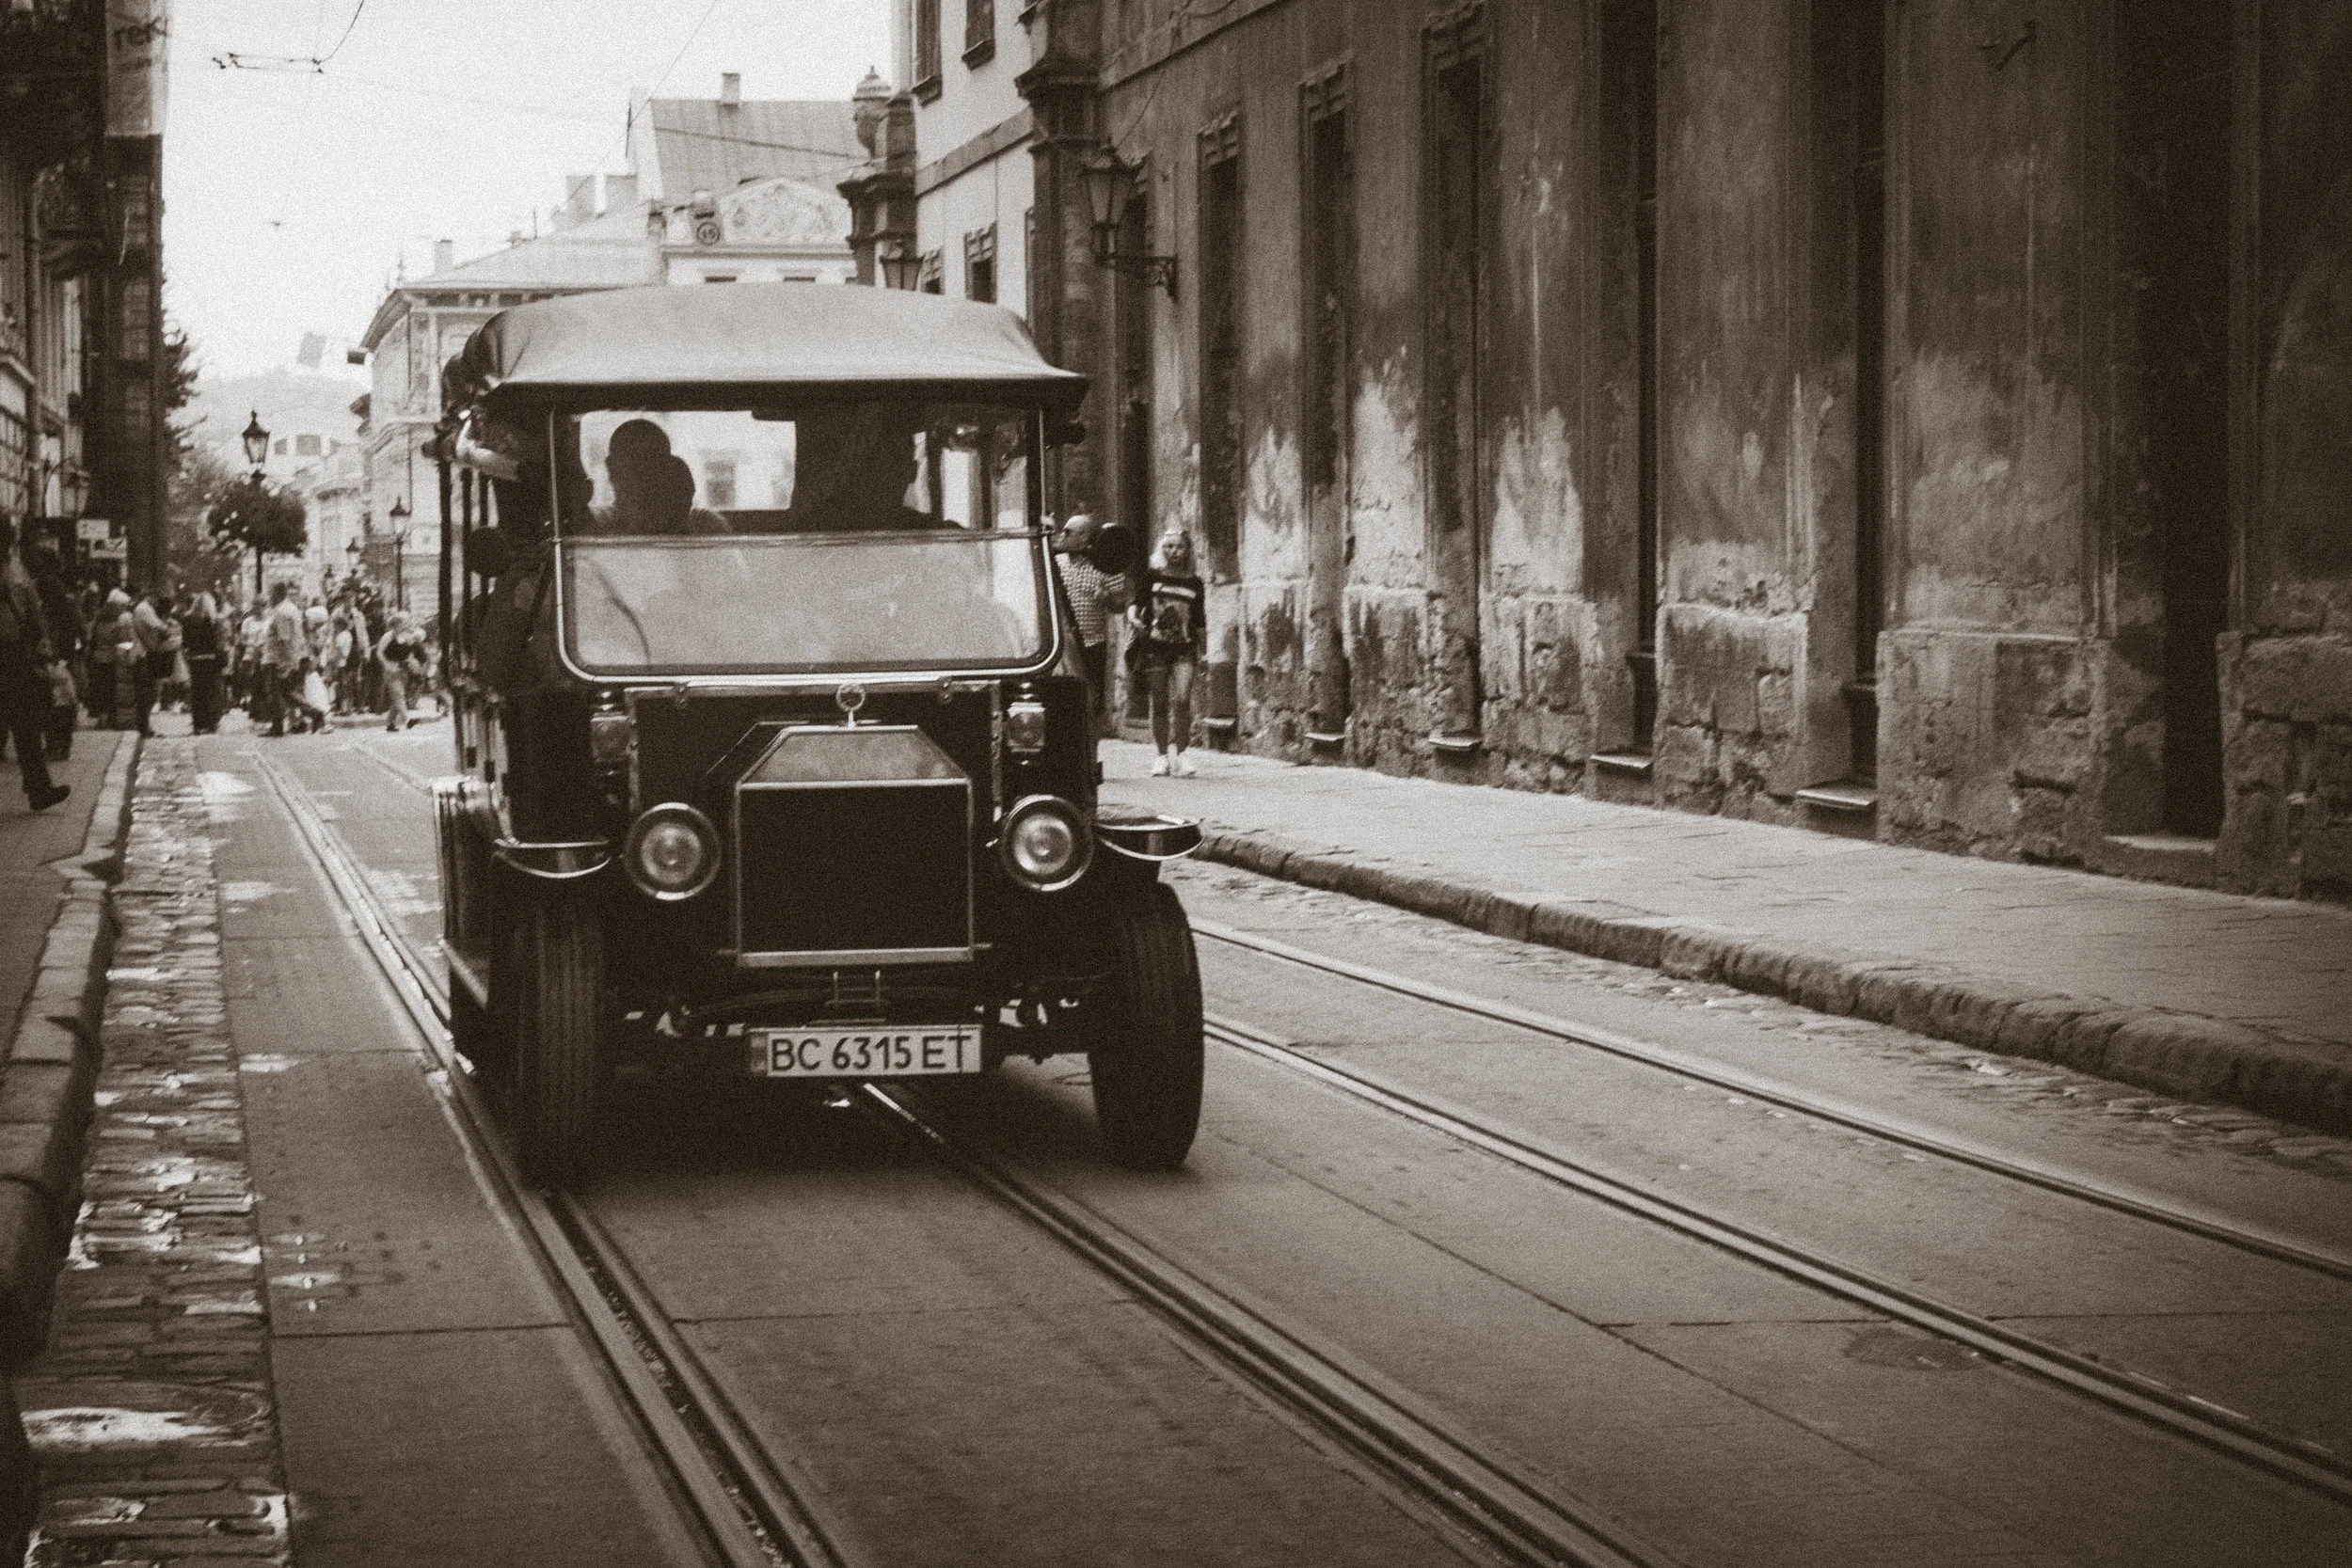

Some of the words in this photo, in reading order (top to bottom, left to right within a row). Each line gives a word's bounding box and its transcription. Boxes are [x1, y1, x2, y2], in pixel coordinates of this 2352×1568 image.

[771, 1037, 821, 1071] BC
[832, 1036, 912, 1070] 6315
[922, 1036, 972, 1069] ET
